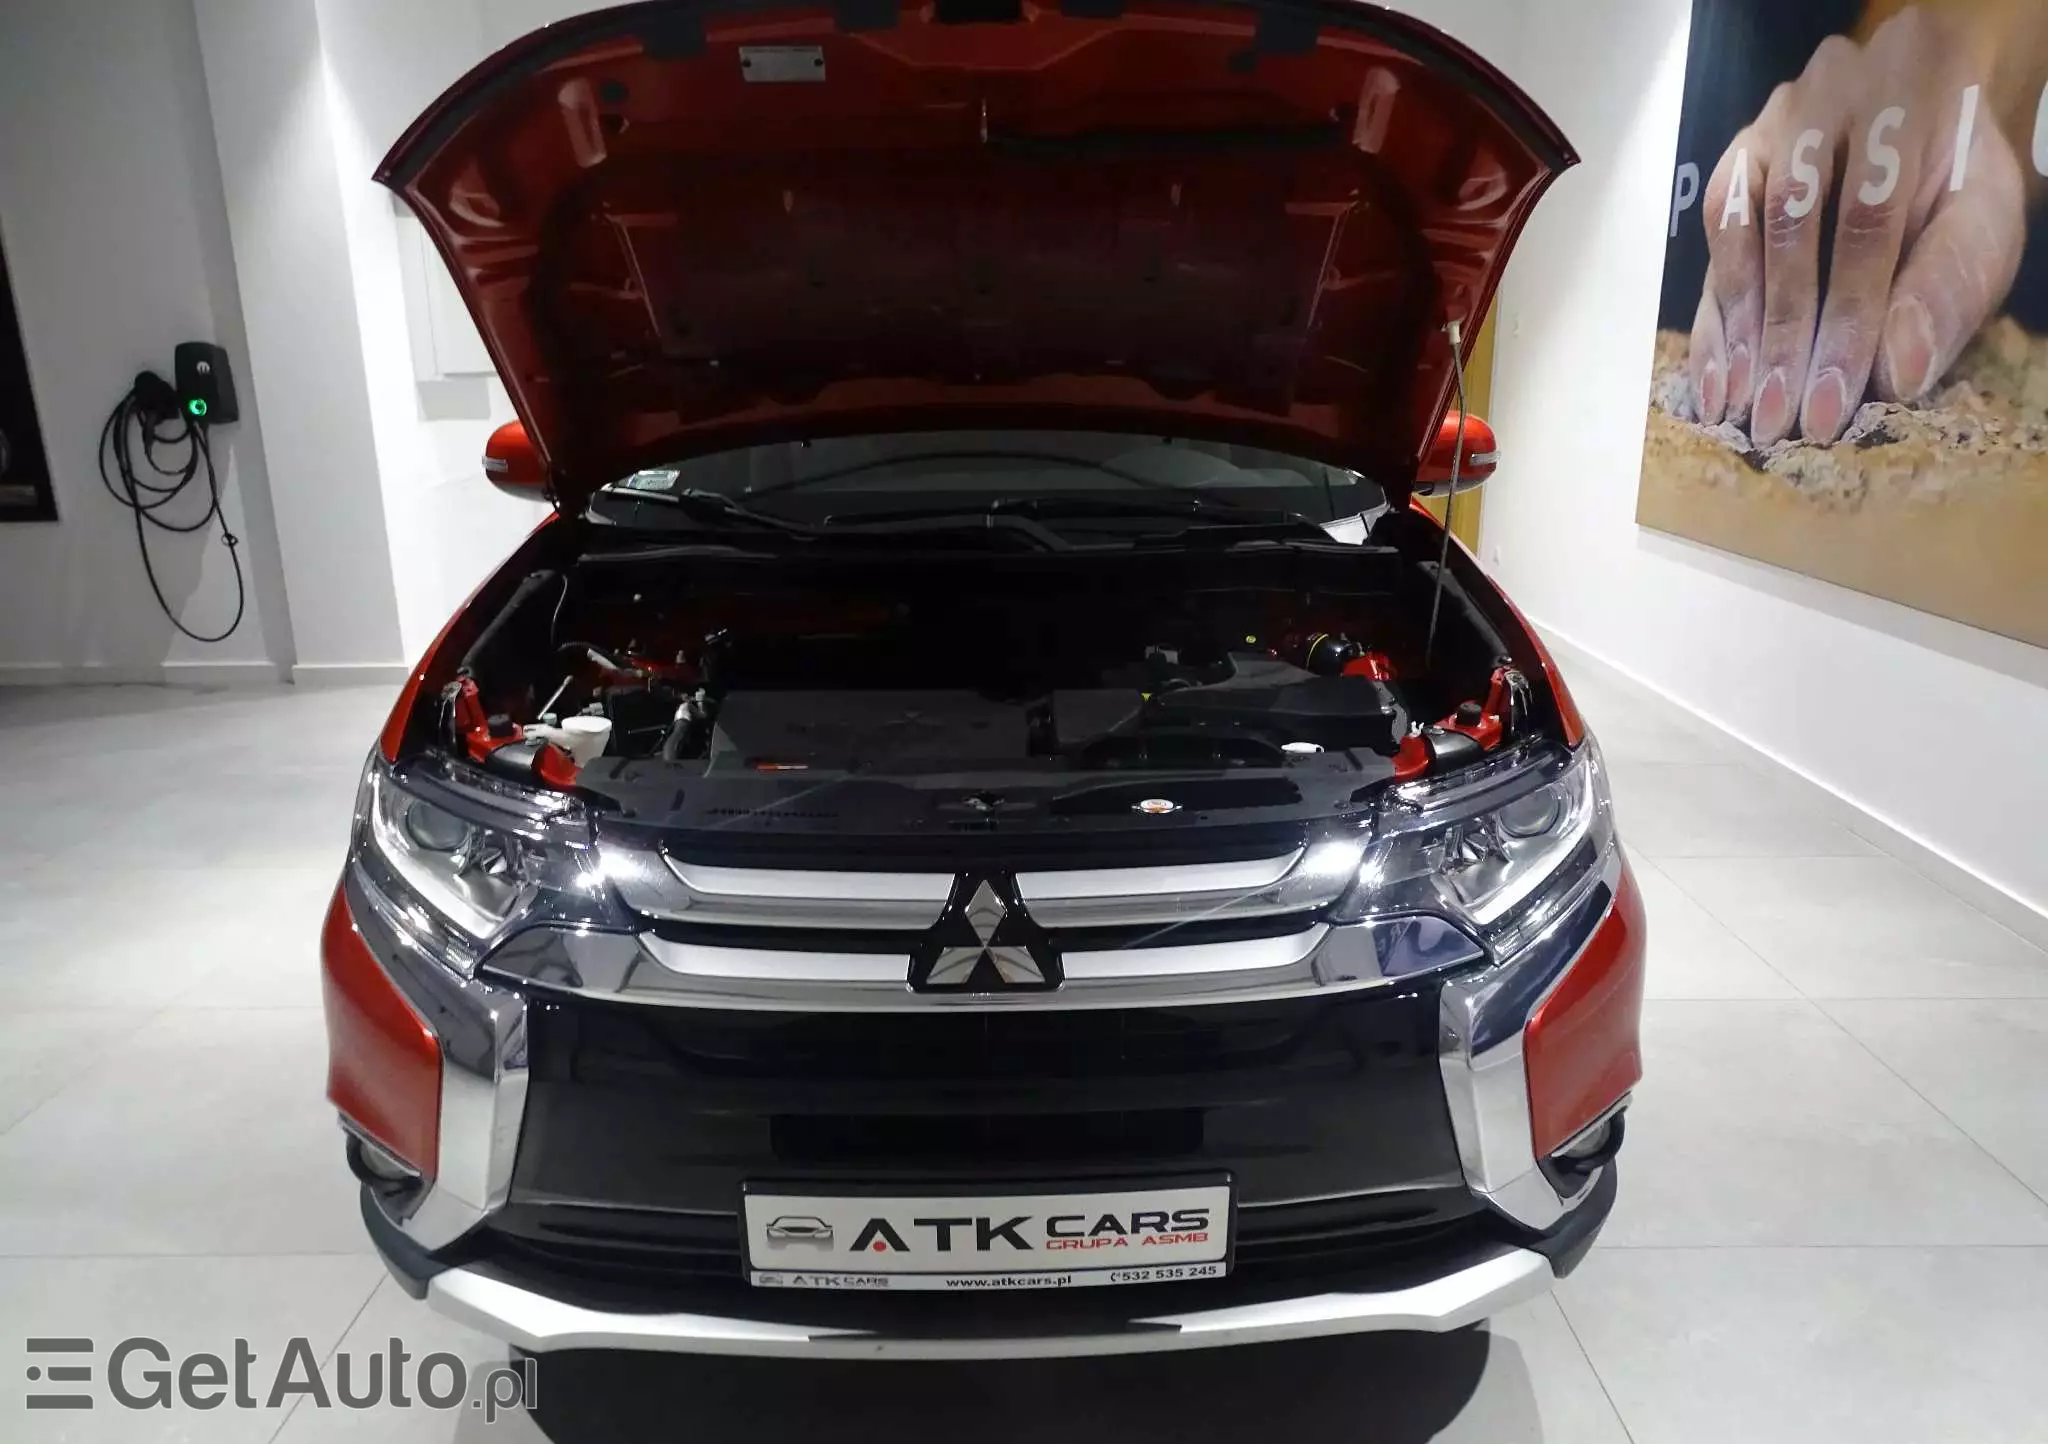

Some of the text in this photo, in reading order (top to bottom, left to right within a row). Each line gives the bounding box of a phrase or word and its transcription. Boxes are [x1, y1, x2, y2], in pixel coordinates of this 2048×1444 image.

[849, 1208, 1210, 1253] ATK CARS
[1046, 1232, 1209, 1250] GRUPA ASMB
[792, 1275, 842, 1287] ATK
[945, 1274, 1072, 1288] www.atkcars.pl
[1122, 1265, 1217, 1281] 532 535 245
